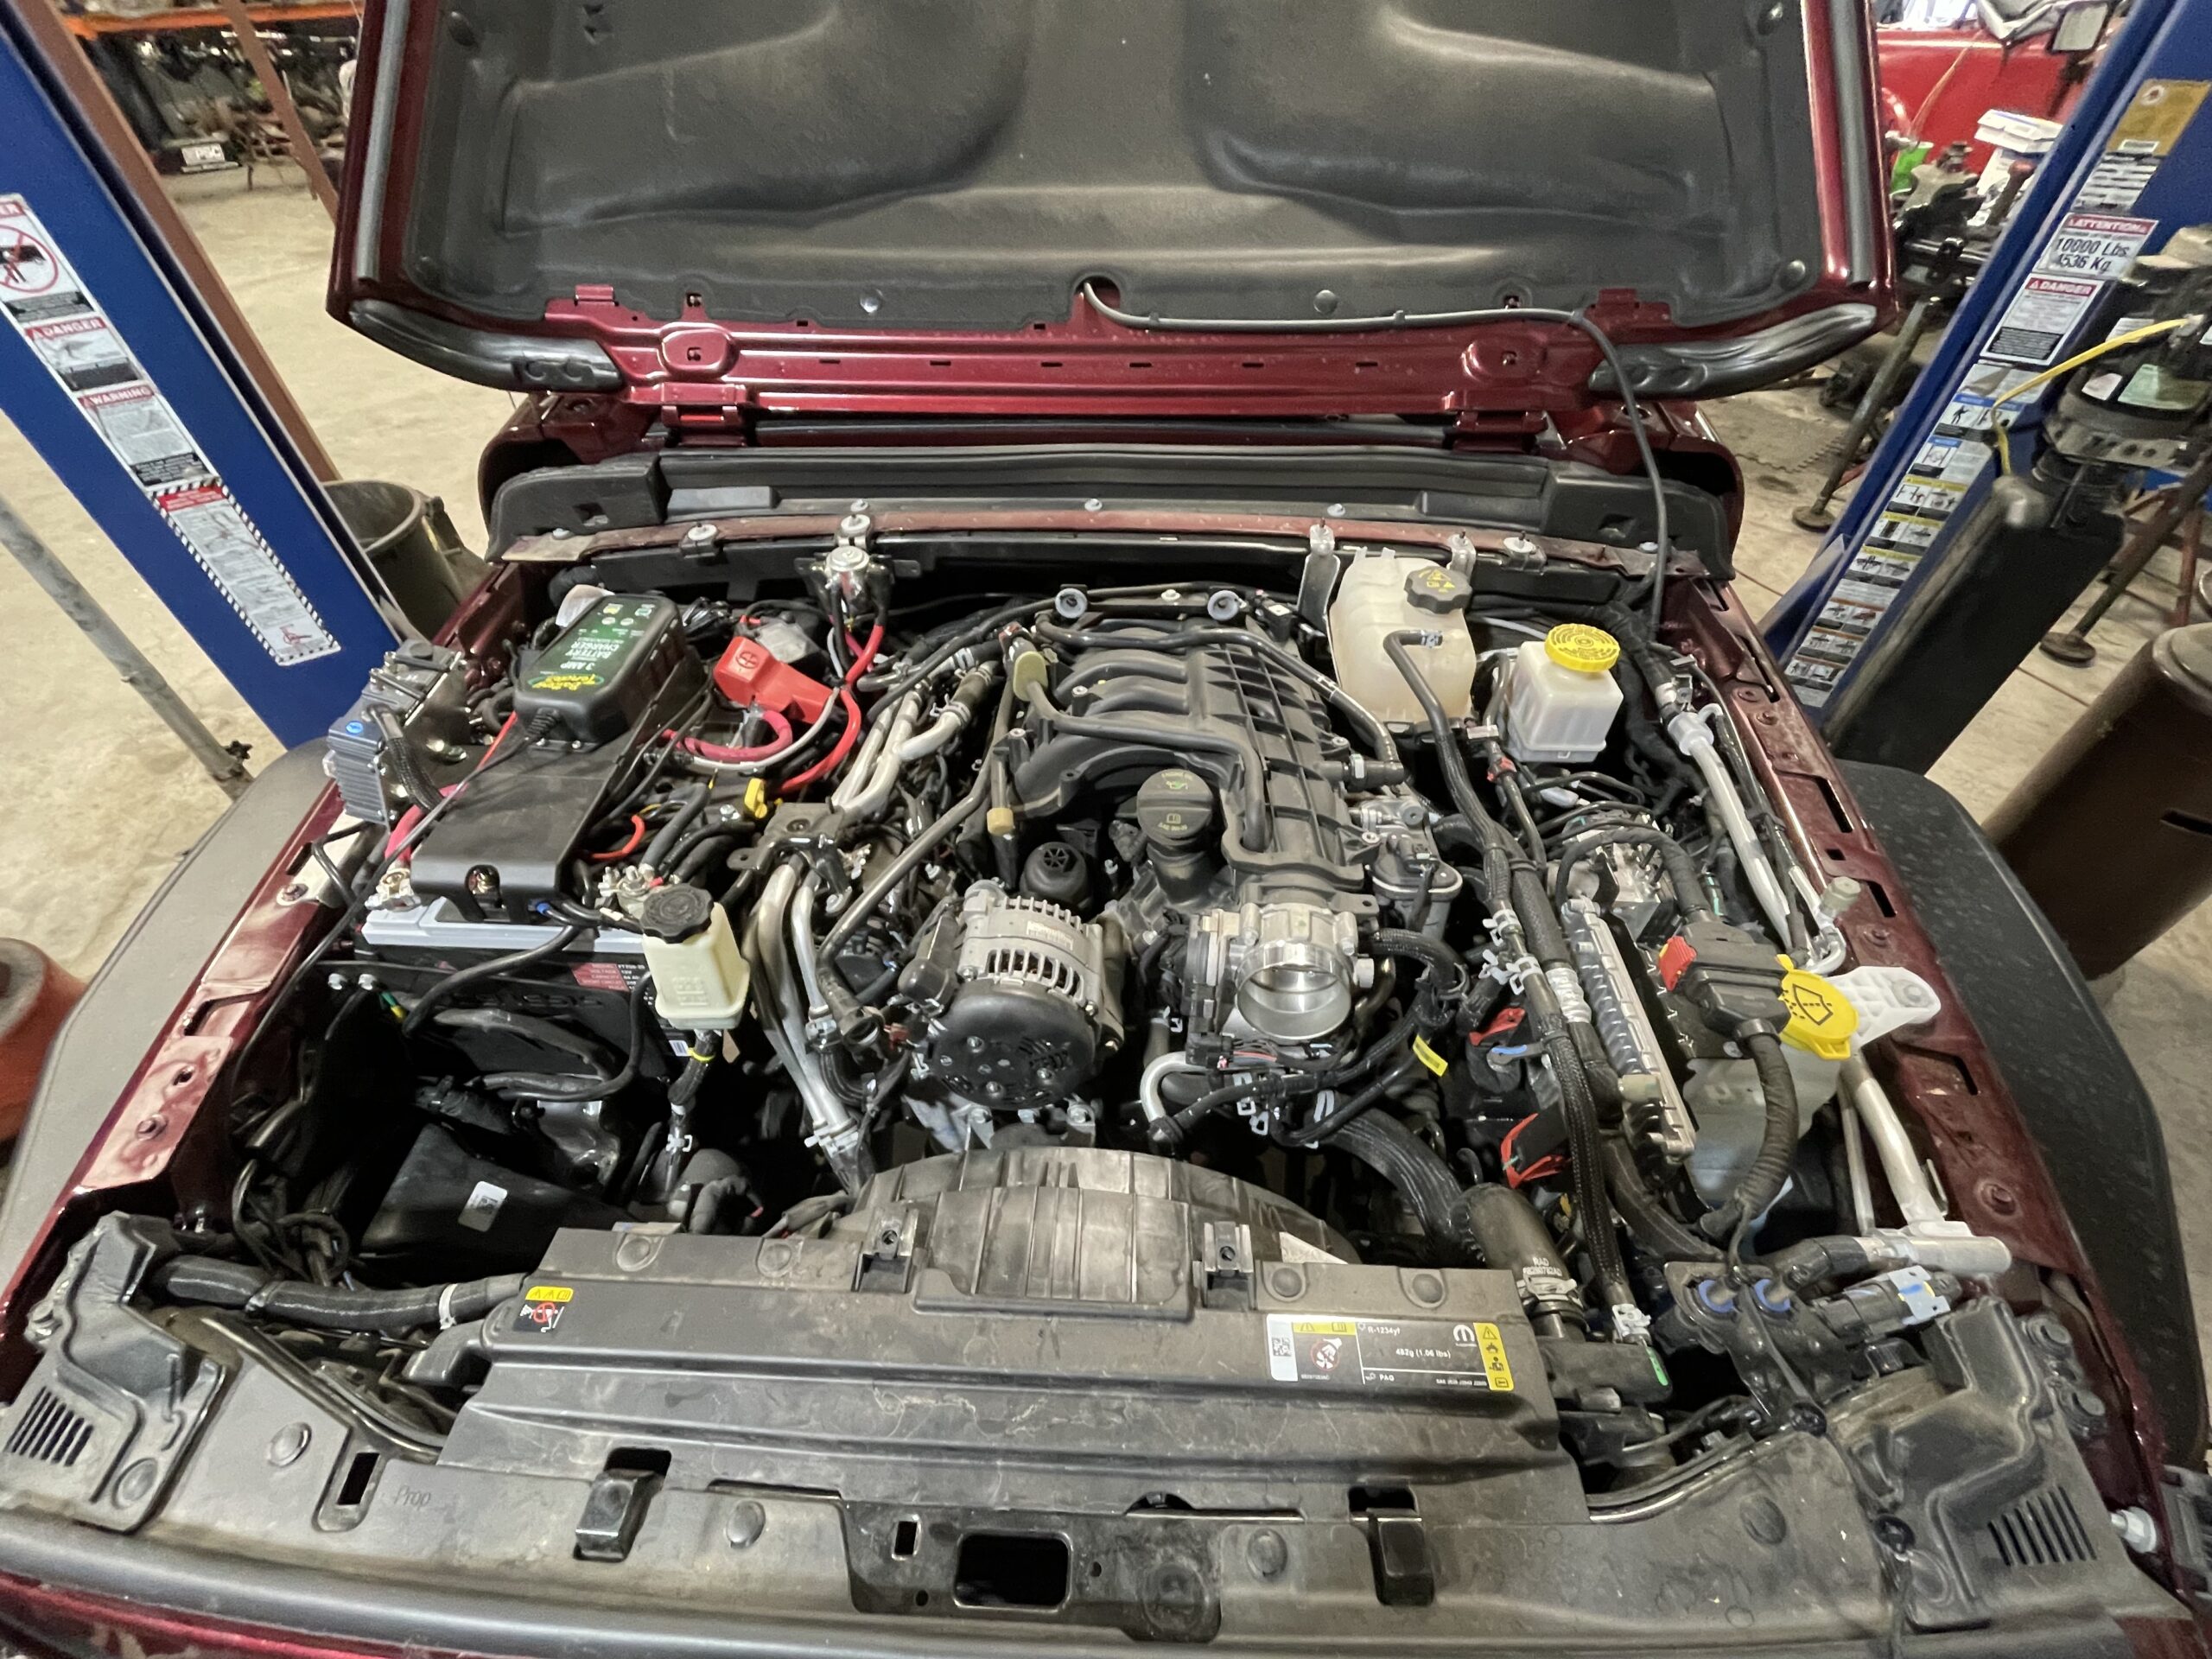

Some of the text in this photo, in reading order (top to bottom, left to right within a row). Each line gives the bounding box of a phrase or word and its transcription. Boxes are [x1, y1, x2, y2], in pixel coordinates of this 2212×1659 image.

[2074, 218, 2139, 232] ATTENTION
[2056, 237, 2130, 257] 10000 Lbs
[2090, 257, 2112, 272] Kg
[2039, 279, 2093, 296] DANGER
[42, 317, 106, 340] DANGER
[90, 386, 151, 405] WARNING
[564, 648, 612, 659] BATTERY
[560, 660, 587, 671] AMP
[585, 662, 595, 671] 3
[1367, 1325, 1401, 1337] R-1234yf
[393, 1484, 431, 1511] Prop
